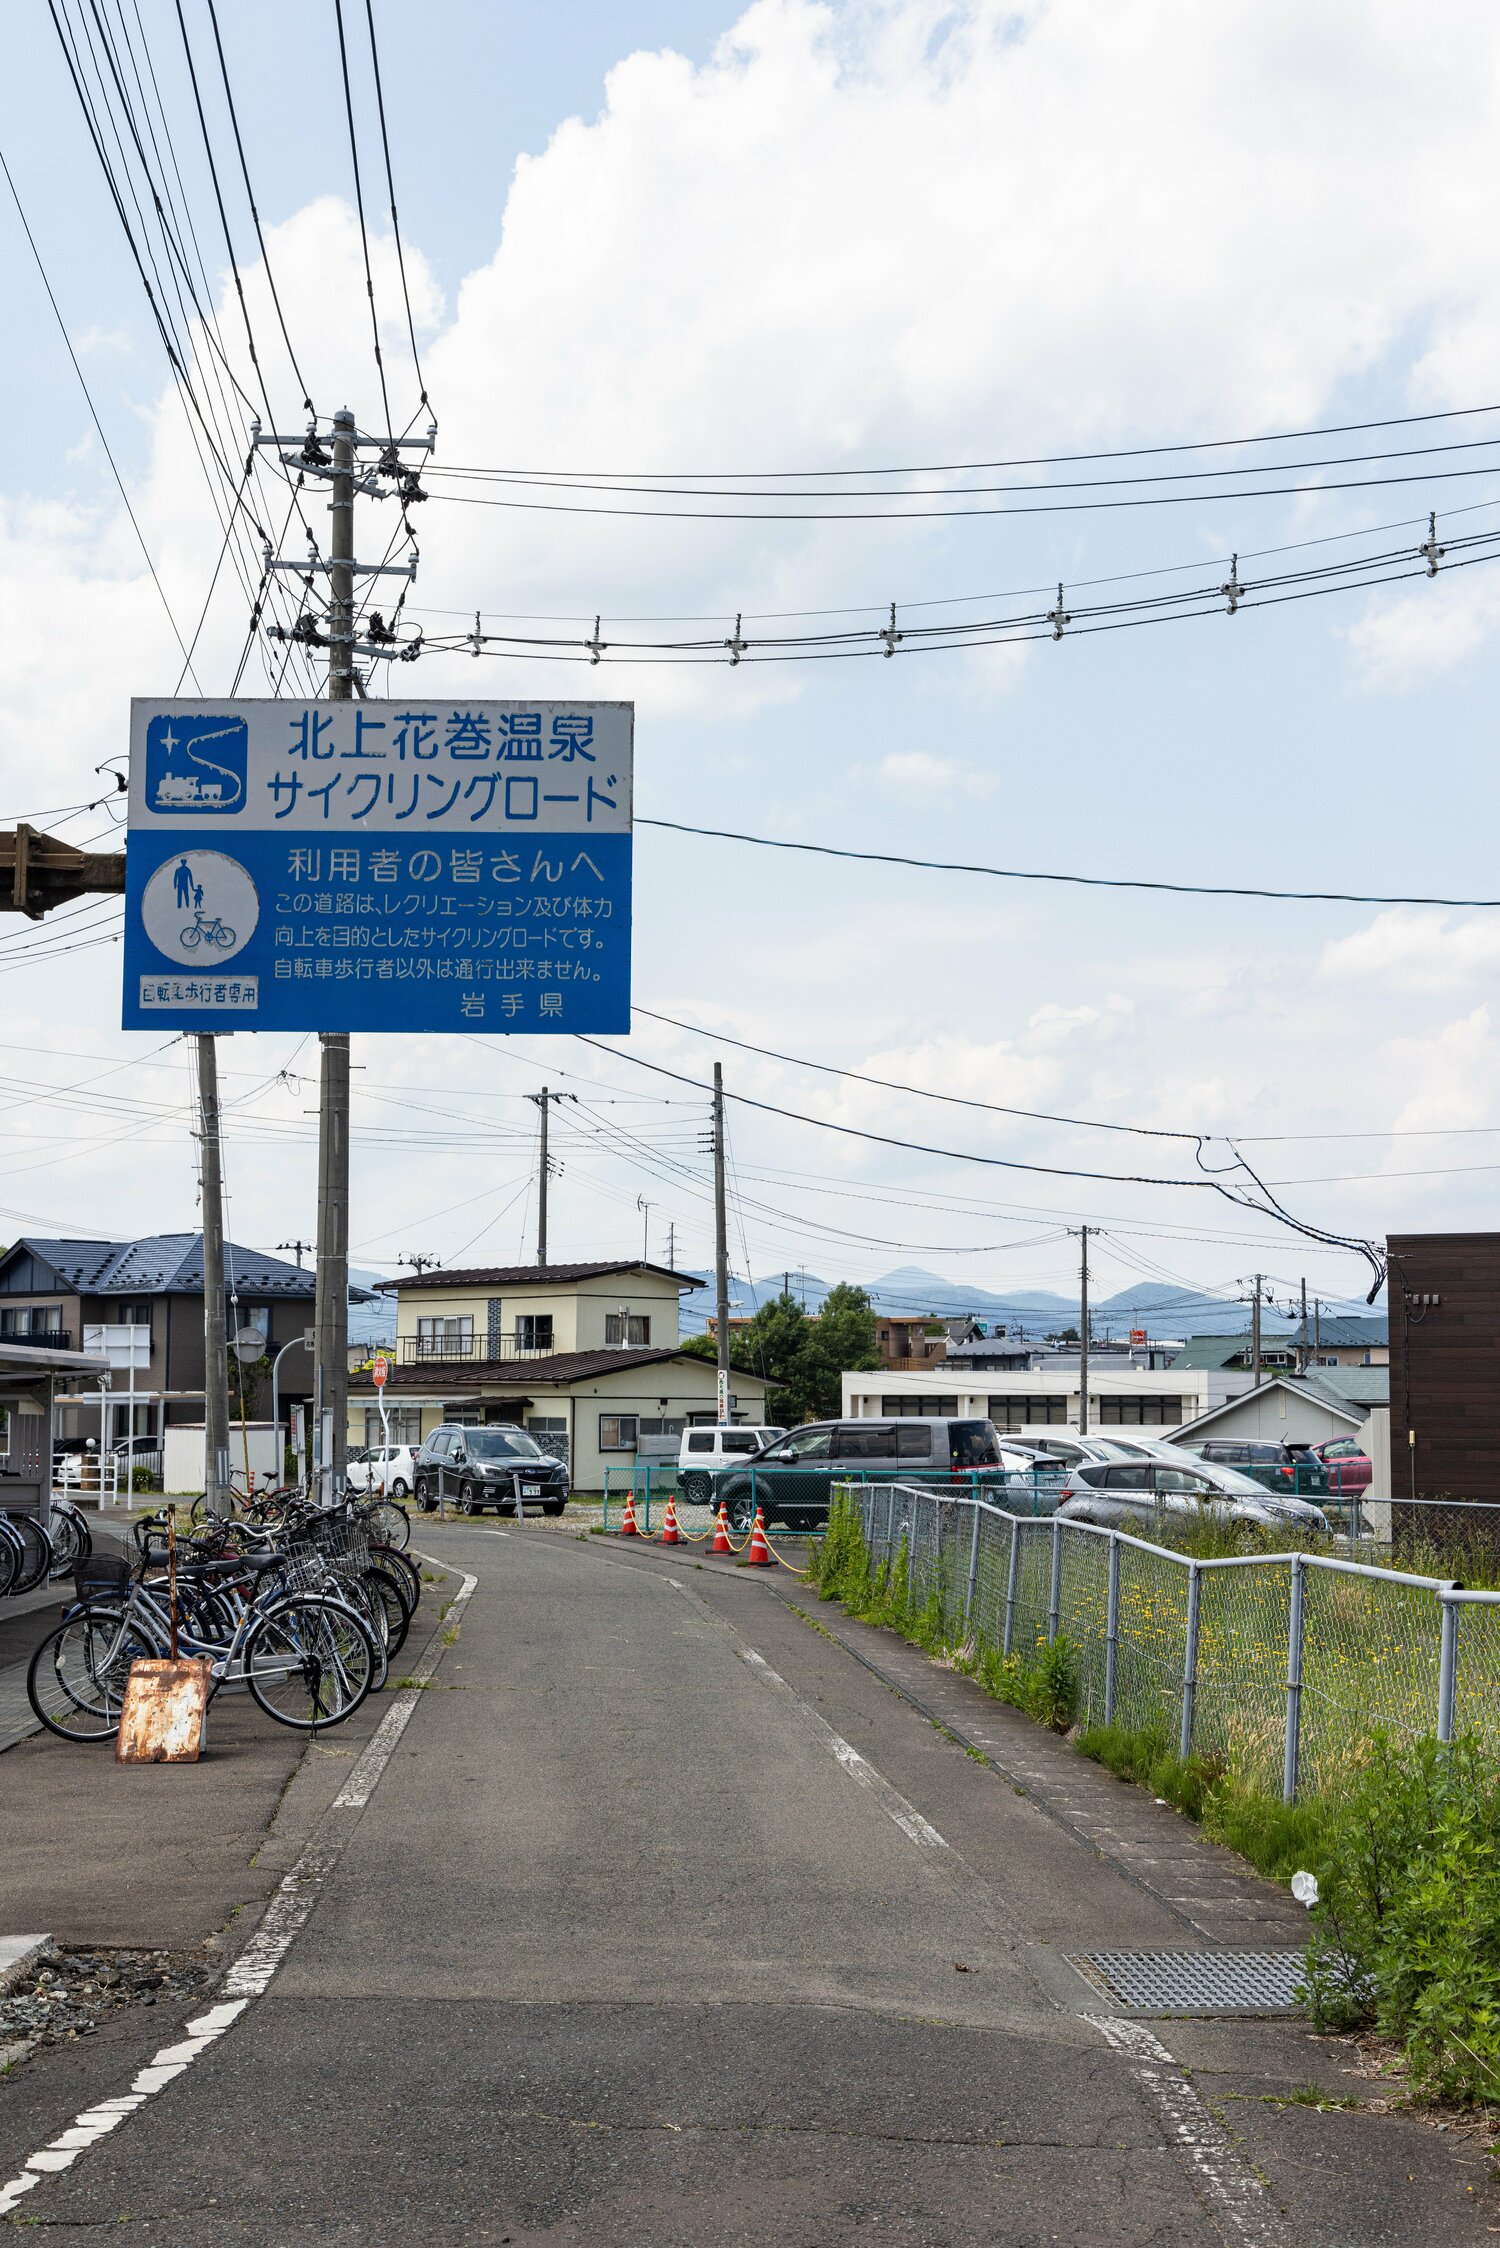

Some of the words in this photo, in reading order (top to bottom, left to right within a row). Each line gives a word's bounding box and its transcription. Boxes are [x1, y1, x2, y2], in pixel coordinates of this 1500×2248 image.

[288, 710, 597, 762] 北上花巻温泉
[267, 771, 618, 822] サイクリングロード
[287, 848, 605, 883] 利用者の皆さんへ
[274, 893, 613, 919] この道路は、レクリエーション及び体力
[274, 925, 604, 950] 向上を目的としたサイクリングロードです。
[274, 957, 601, 982] 自転車歩行者以外は通行出来ません。
[460, 992, 564, 1018] 岩手県
